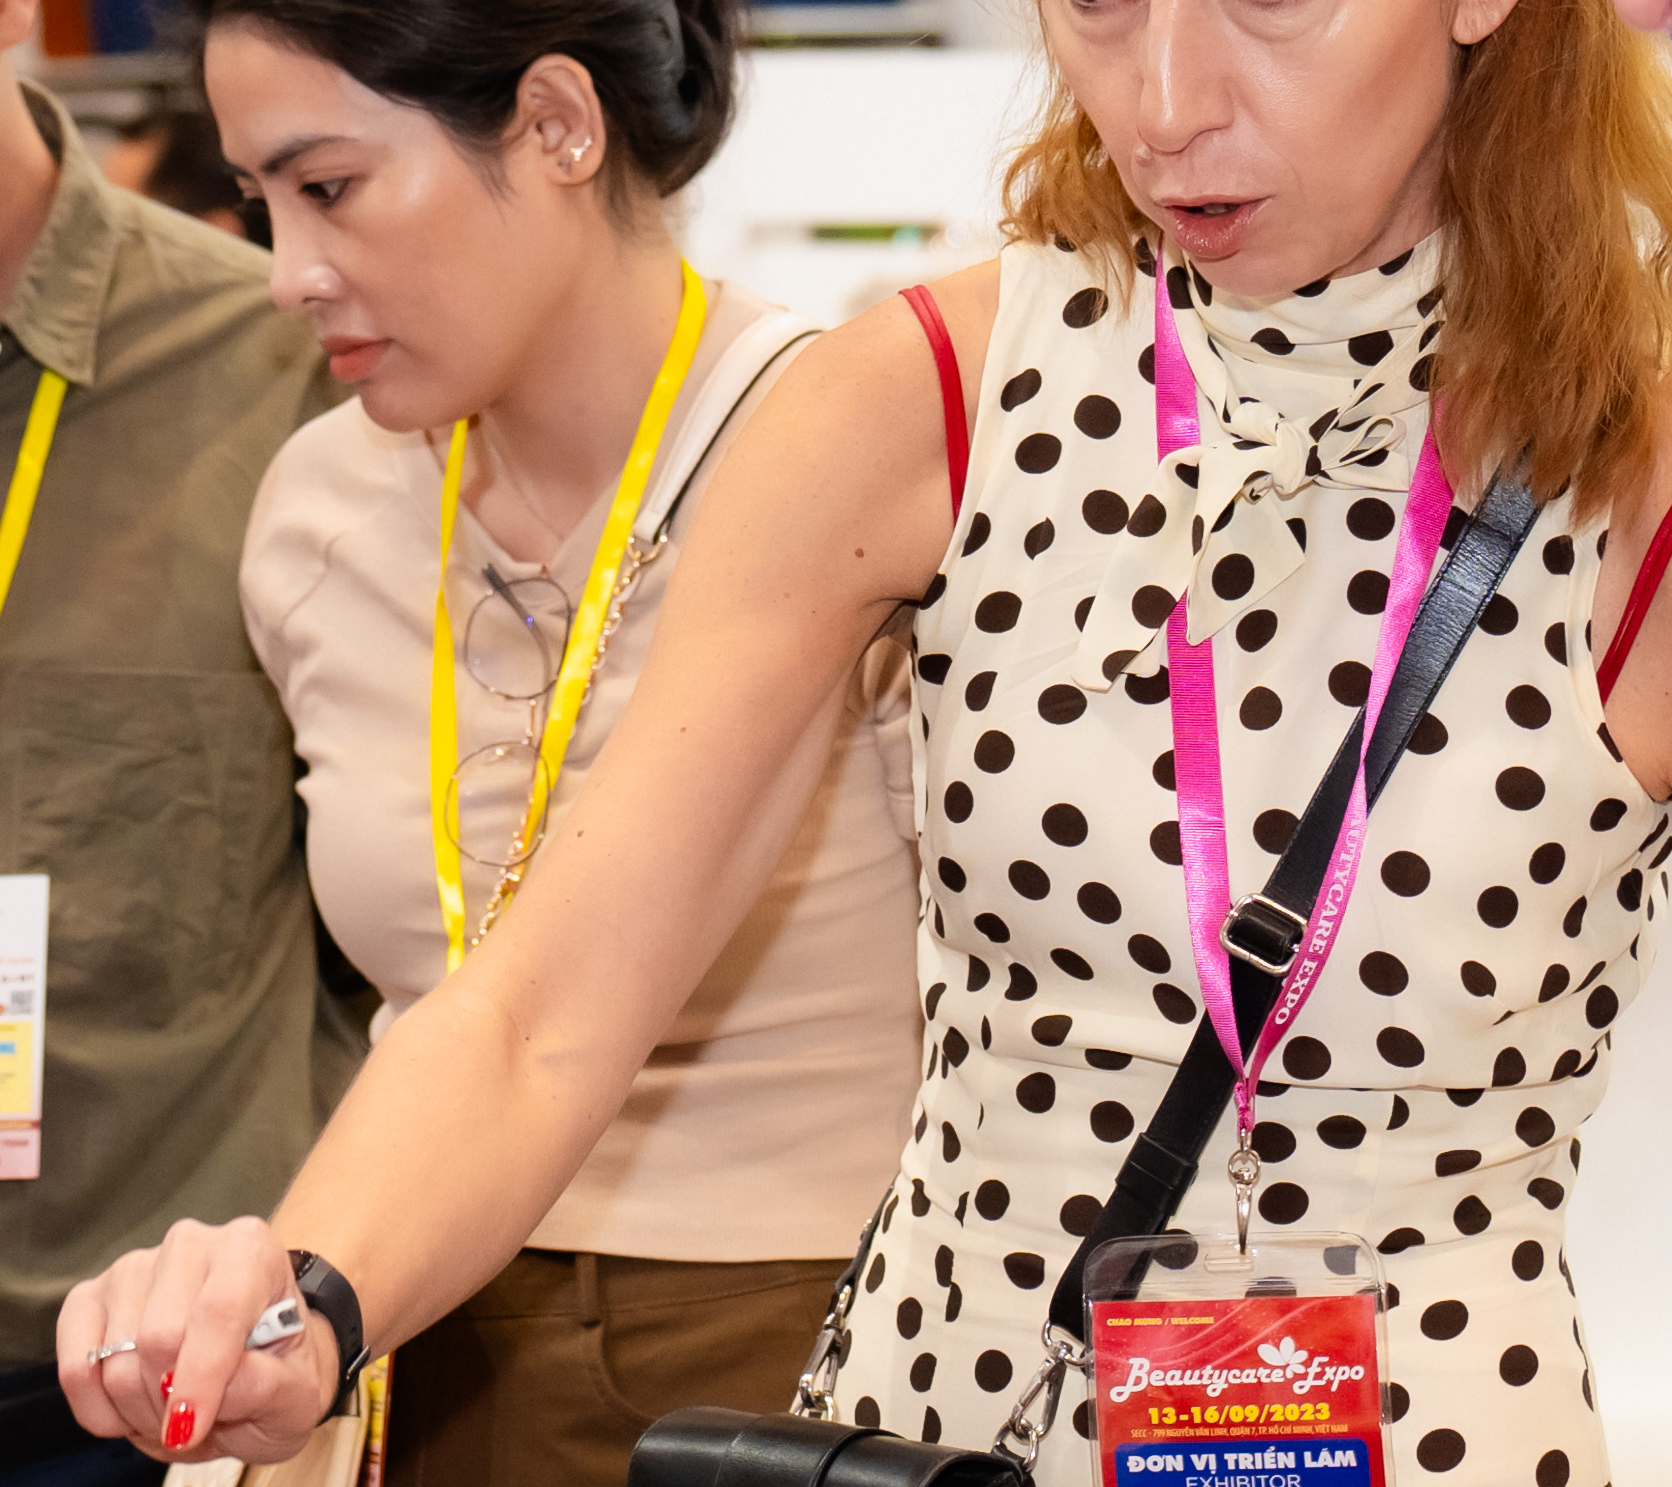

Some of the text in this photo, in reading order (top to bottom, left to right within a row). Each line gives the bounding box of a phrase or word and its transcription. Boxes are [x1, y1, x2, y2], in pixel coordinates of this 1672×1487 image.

[1274, 957, 1319, 1026] EXPO
[1109, 1355, 1365, 1403] Beautycare Expo
[1148, 1402, 1331, 1424] 13-16/09/2023
[1153, 1428, 1166, 1438] 799
[1126, 1445, 1358, 1475] ĐƠN VỊ TRIỂN LÃM
